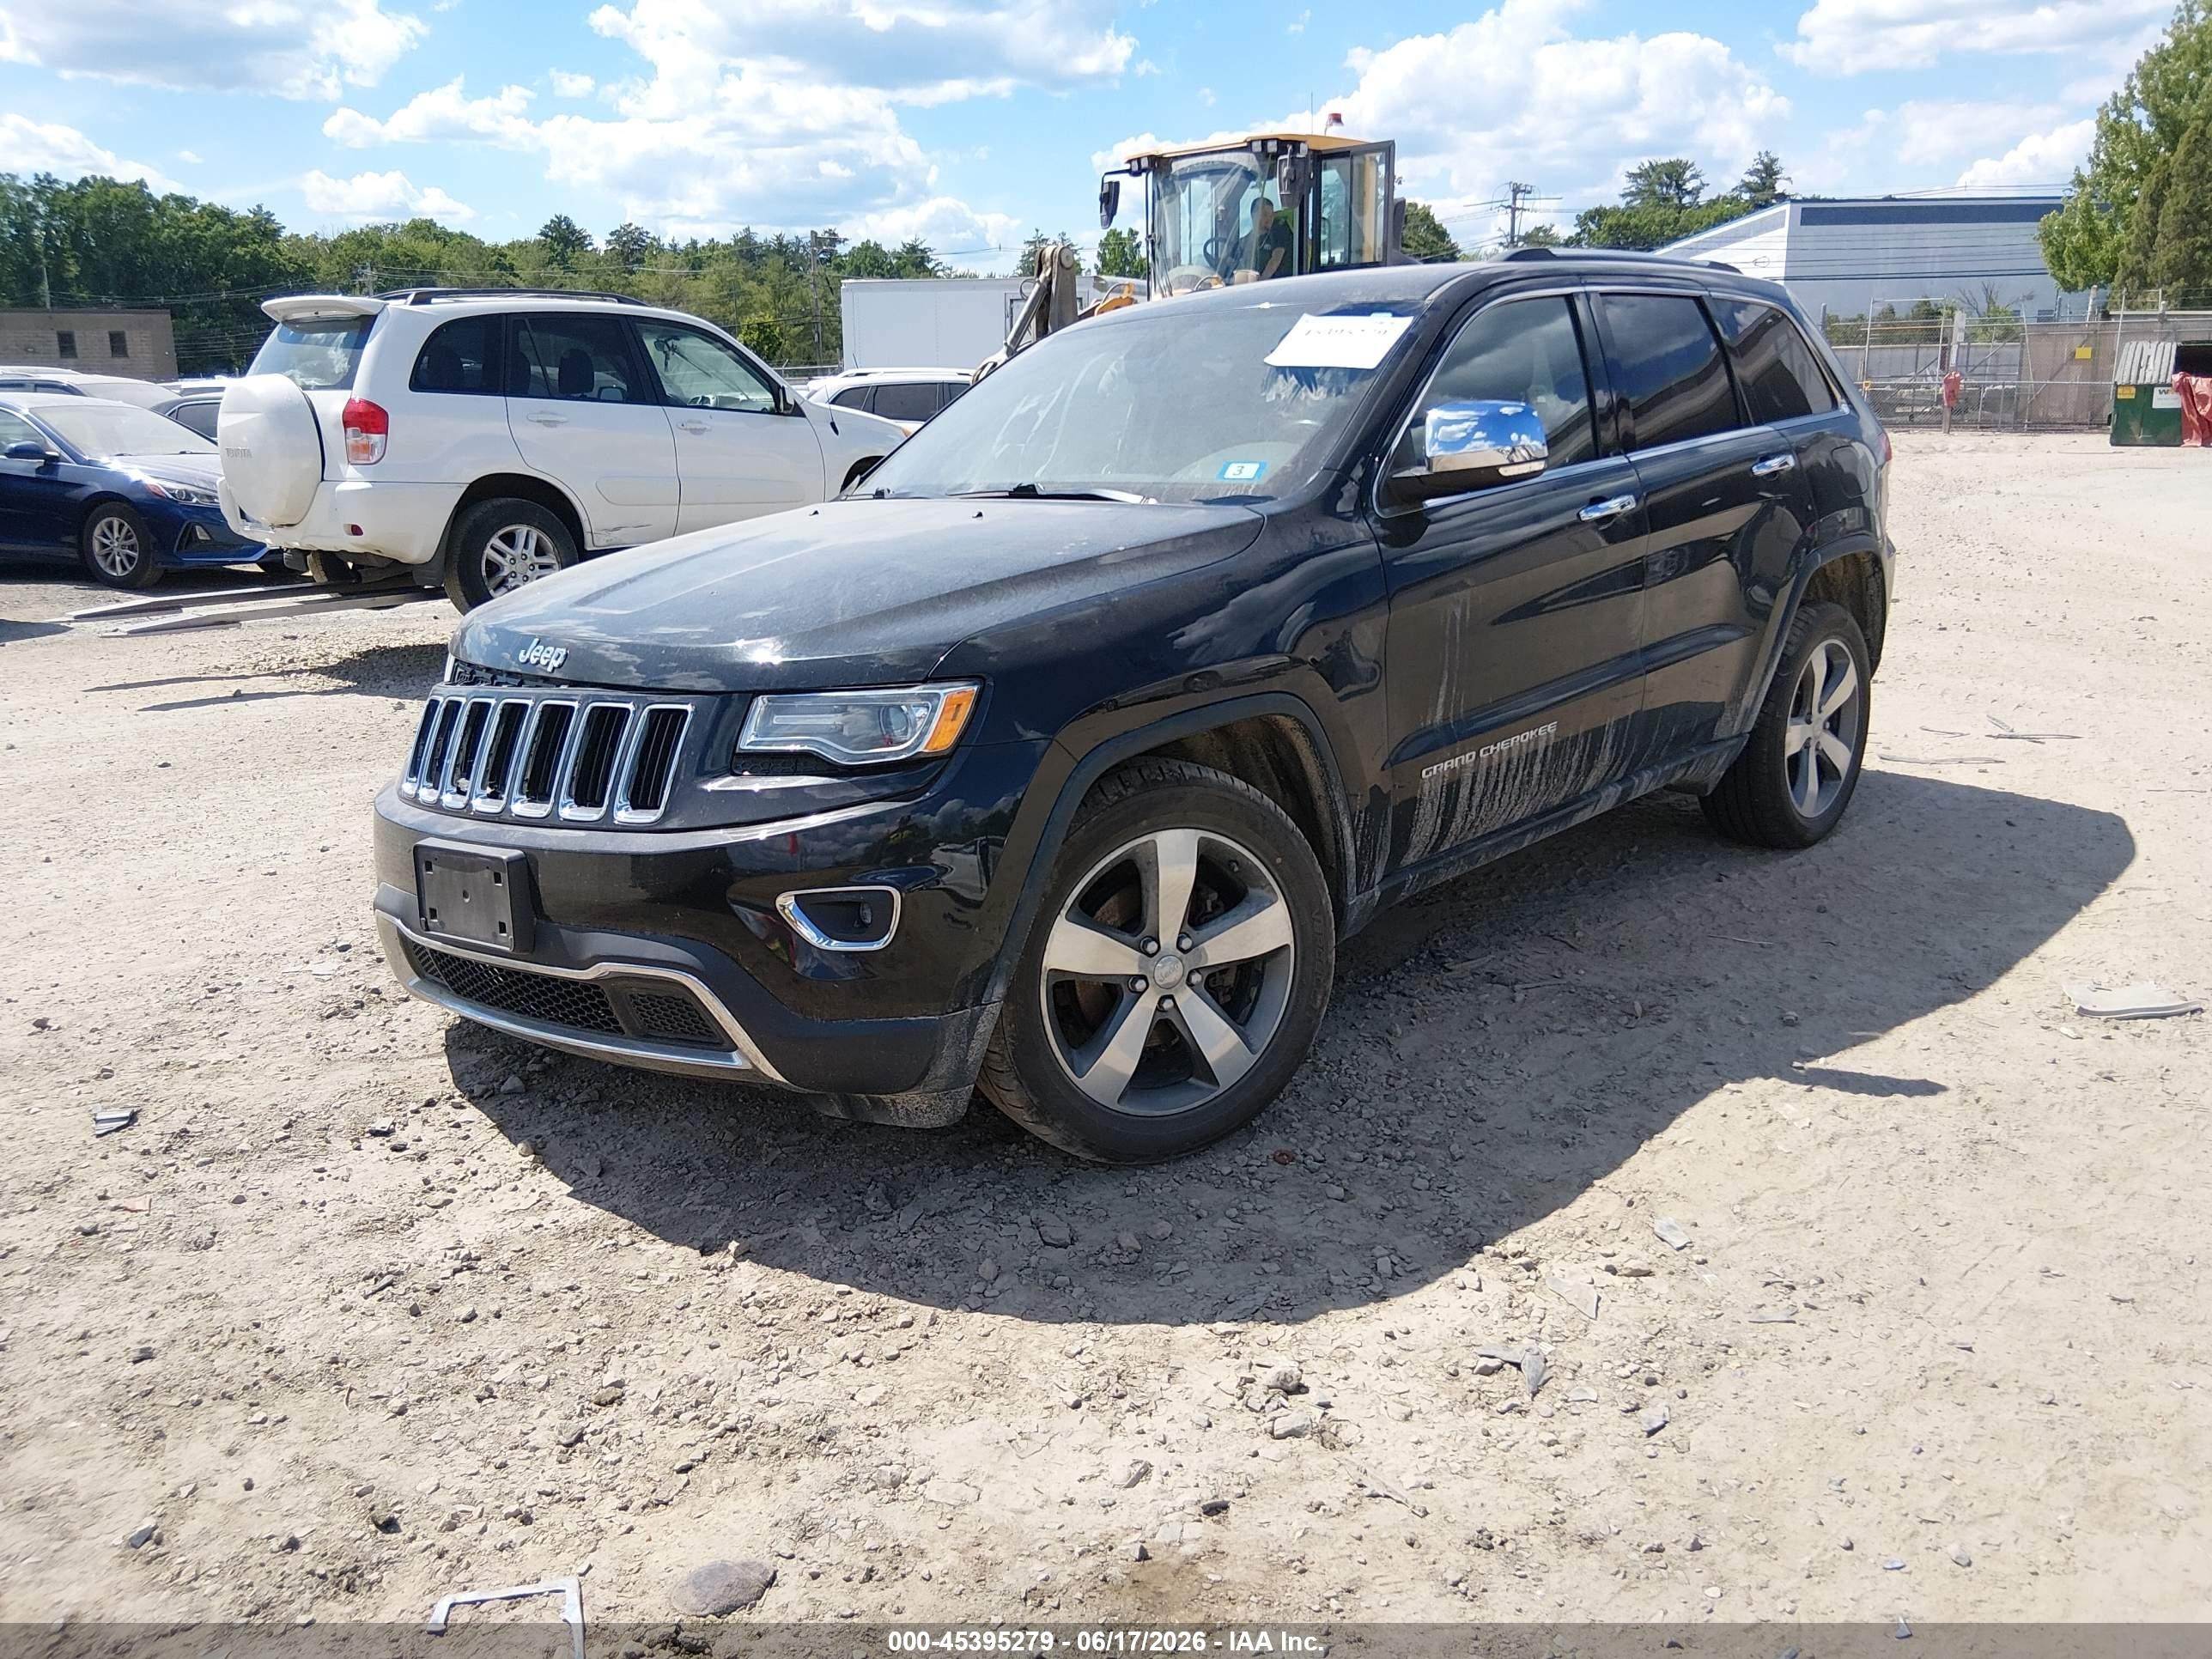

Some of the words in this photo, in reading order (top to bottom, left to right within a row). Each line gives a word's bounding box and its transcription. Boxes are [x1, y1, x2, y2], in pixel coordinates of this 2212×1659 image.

[1232, 465, 1244, 476] 3
[519, 637, 568, 672] Jeep
[1421, 750, 1476, 779] GRAND
[1480, 720, 1559, 757] CHEROKEE
